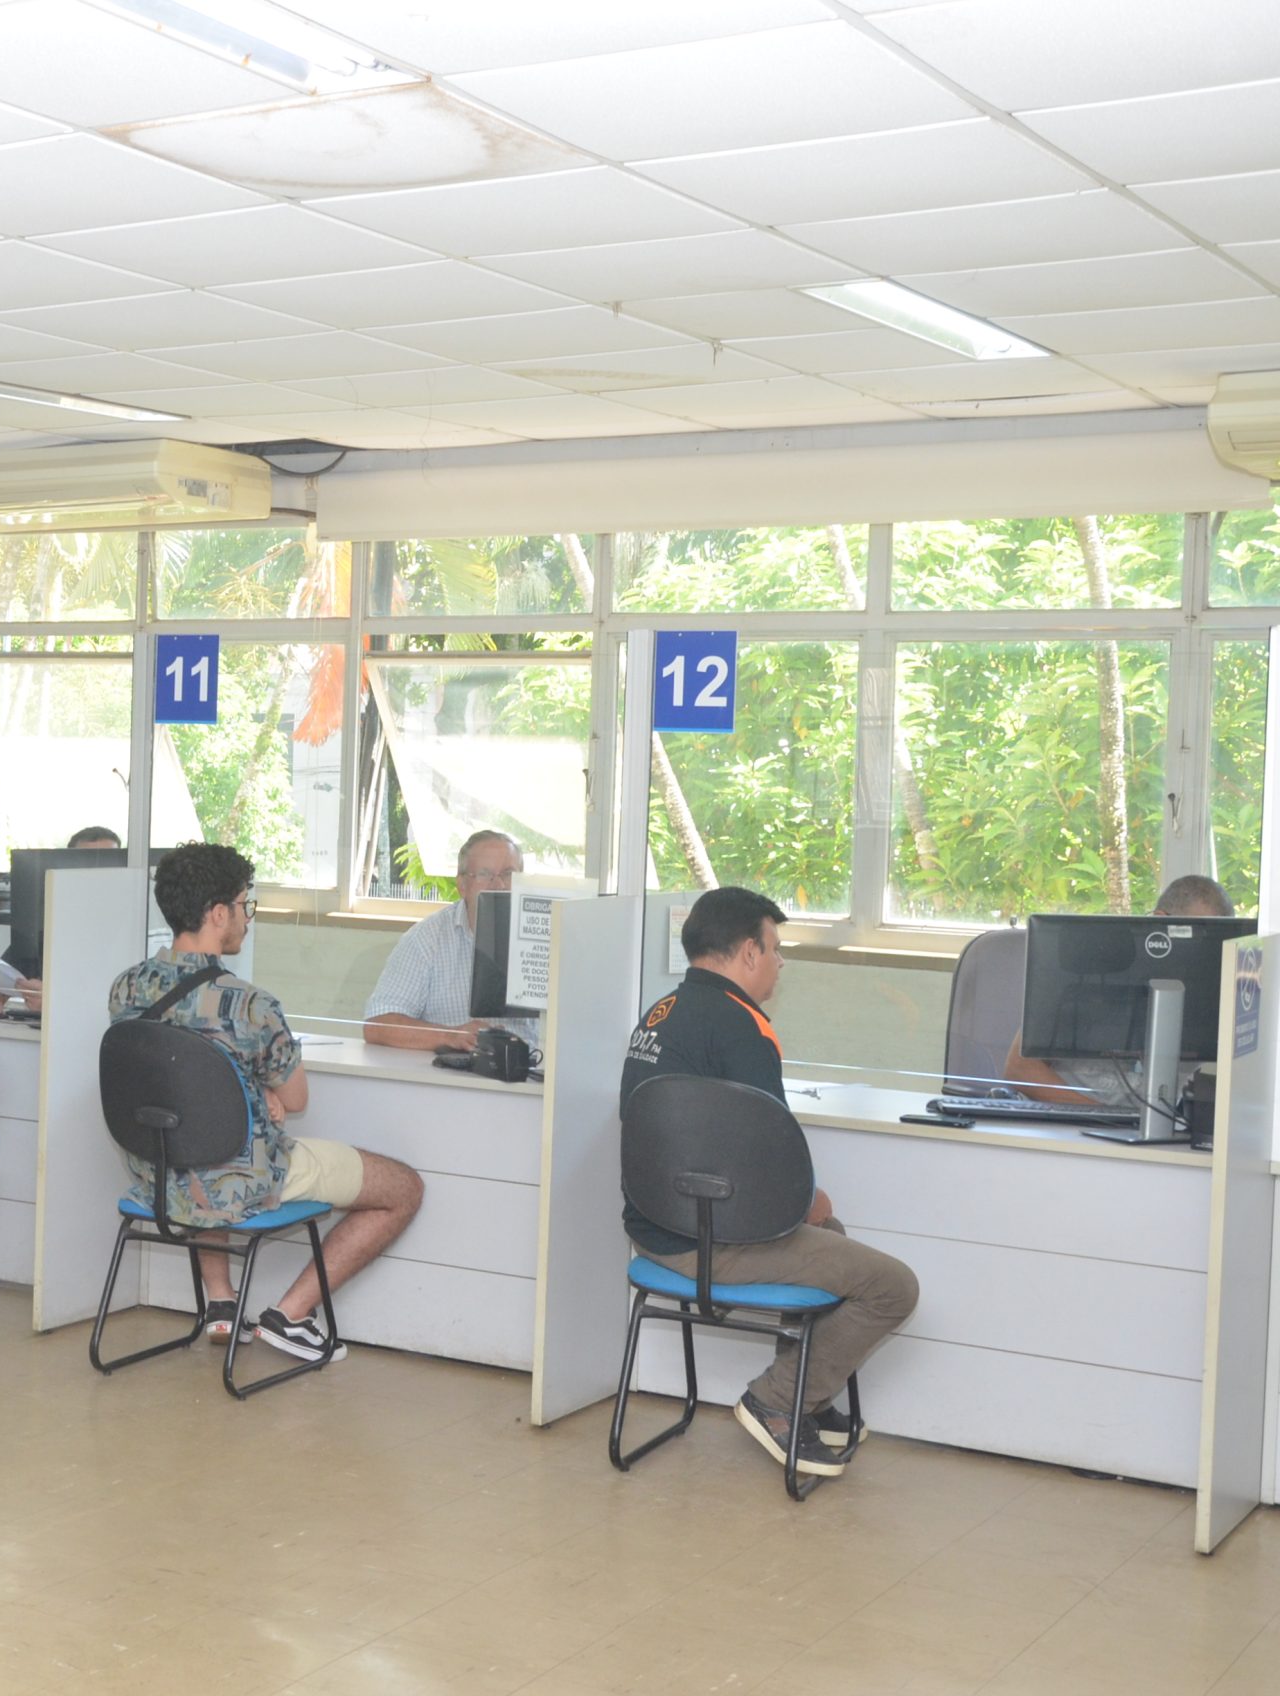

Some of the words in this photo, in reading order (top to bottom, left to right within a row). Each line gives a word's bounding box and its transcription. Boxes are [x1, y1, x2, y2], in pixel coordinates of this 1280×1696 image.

[165, 656, 209, 702] 11
[661, 655, 729, 708] 12
[524, 901, 551, 912] OBRIGA
[526, 915, 540, 925] USO
[540, 917, 549, 926] DE
[532, 944, 549, 952] ATEN
[1148, 941, 1169, 949] DELL
[523, 975, 549, 984] PESSOA
[527, 983, 546, 991] FOTO
[651, 1043, 662, 1054] FM
